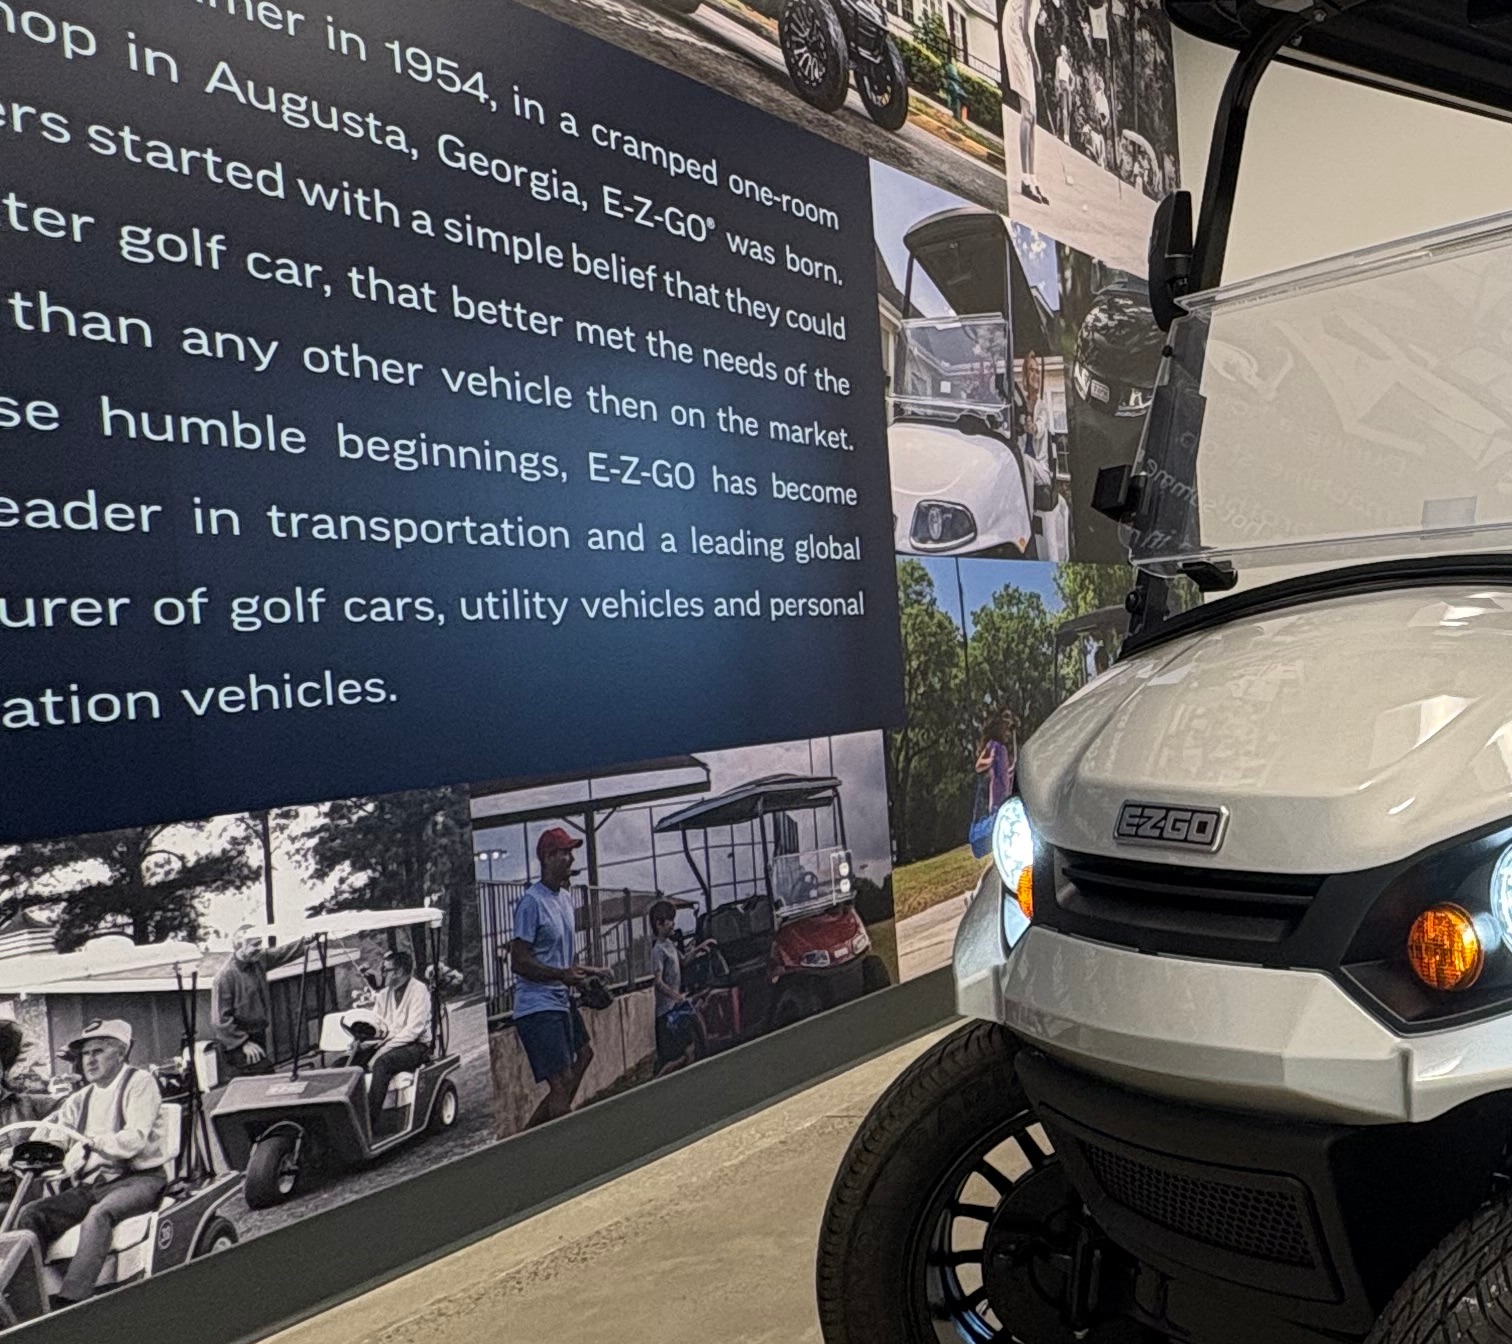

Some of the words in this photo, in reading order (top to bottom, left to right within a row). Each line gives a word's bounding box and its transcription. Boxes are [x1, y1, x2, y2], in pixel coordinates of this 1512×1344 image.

[127, 31, 179, 84] in
[204, 60, 419, 161] Augusta,
[437, 133, 588, 212] Georgia,
[725, 231, 776, 265] was
[785, 243, 843, 286] born.
[326, 15, 367, 62] in
[384, 39, 498, 113] 1954,
[512, 84, 546, 125] in
[559, 111, 580, 138] a
[591, 123, 718, 187] cramped
[728, 174, 840, 231] one-room
[0, 102, 71, 144] rs
[87, 124, 286, 200] started
[295, 178, 401, 229] with
[411, 209, 436, 238] a
[443, 213, 564, 269] simple
[571, 241, 658, 292] belief
[662, 270, 721, 309] that
[724, 287, 781, 328] they
[785, 309, 847, 341] could
[1, 191, 96, 243] ter
[118, 224, 228, 270] golf
[246, 251, 332, 298] car,
[346, 265, 438, 313] that
[451, 284, 564, 337] better
[575, 320, 637, 353] met
[645, 329, 694, 364] the
[702, 347, 778, 381] needs
[784, 362, 808, 388] of
[813, 366, 851, 396] the
[7, 290, 153, 348] than
[181, 326, 279, 372] any
[303, 342, 424, 387] other
[440, 365, 574, 409] vehicle
[585, 383, 658, 422] then
[670, 404, 706, 429] on
[716, 405, 759, 437] the
[769, 420, 854, 451] market.
[100, 394, 307, 454] humble
[336, 421, 568, 483] beginnings,
[588, 451, 695, 490] E-Z-GO
[712, 464, 758, 497] has
[771, 471, 858, 506] become
[192, 496, 241, 536] in
[265, 504, 570, 550] transportation
[587, 522, 645, 552] and
[660, 532, 678, 553] a
[690, 525, 786, 563] leading
[794, 533, 861, 564] global
[0, 596, 131, 628] urer
[153, 586, 209, 626] of
[230, 585, 327, 632] golf
[343, 596, 445, 627] cars,
[459, 587, 569, 626] utility
[580, 588, 705, 619] vehicles
[713, 589, 761, 618] and
[769, 590, 865, 622] personal
[1, 683, 161, 729] ation
[180, 669, 398, 716] vehicles.
[1117, 806, 1219, 843] EZGO
